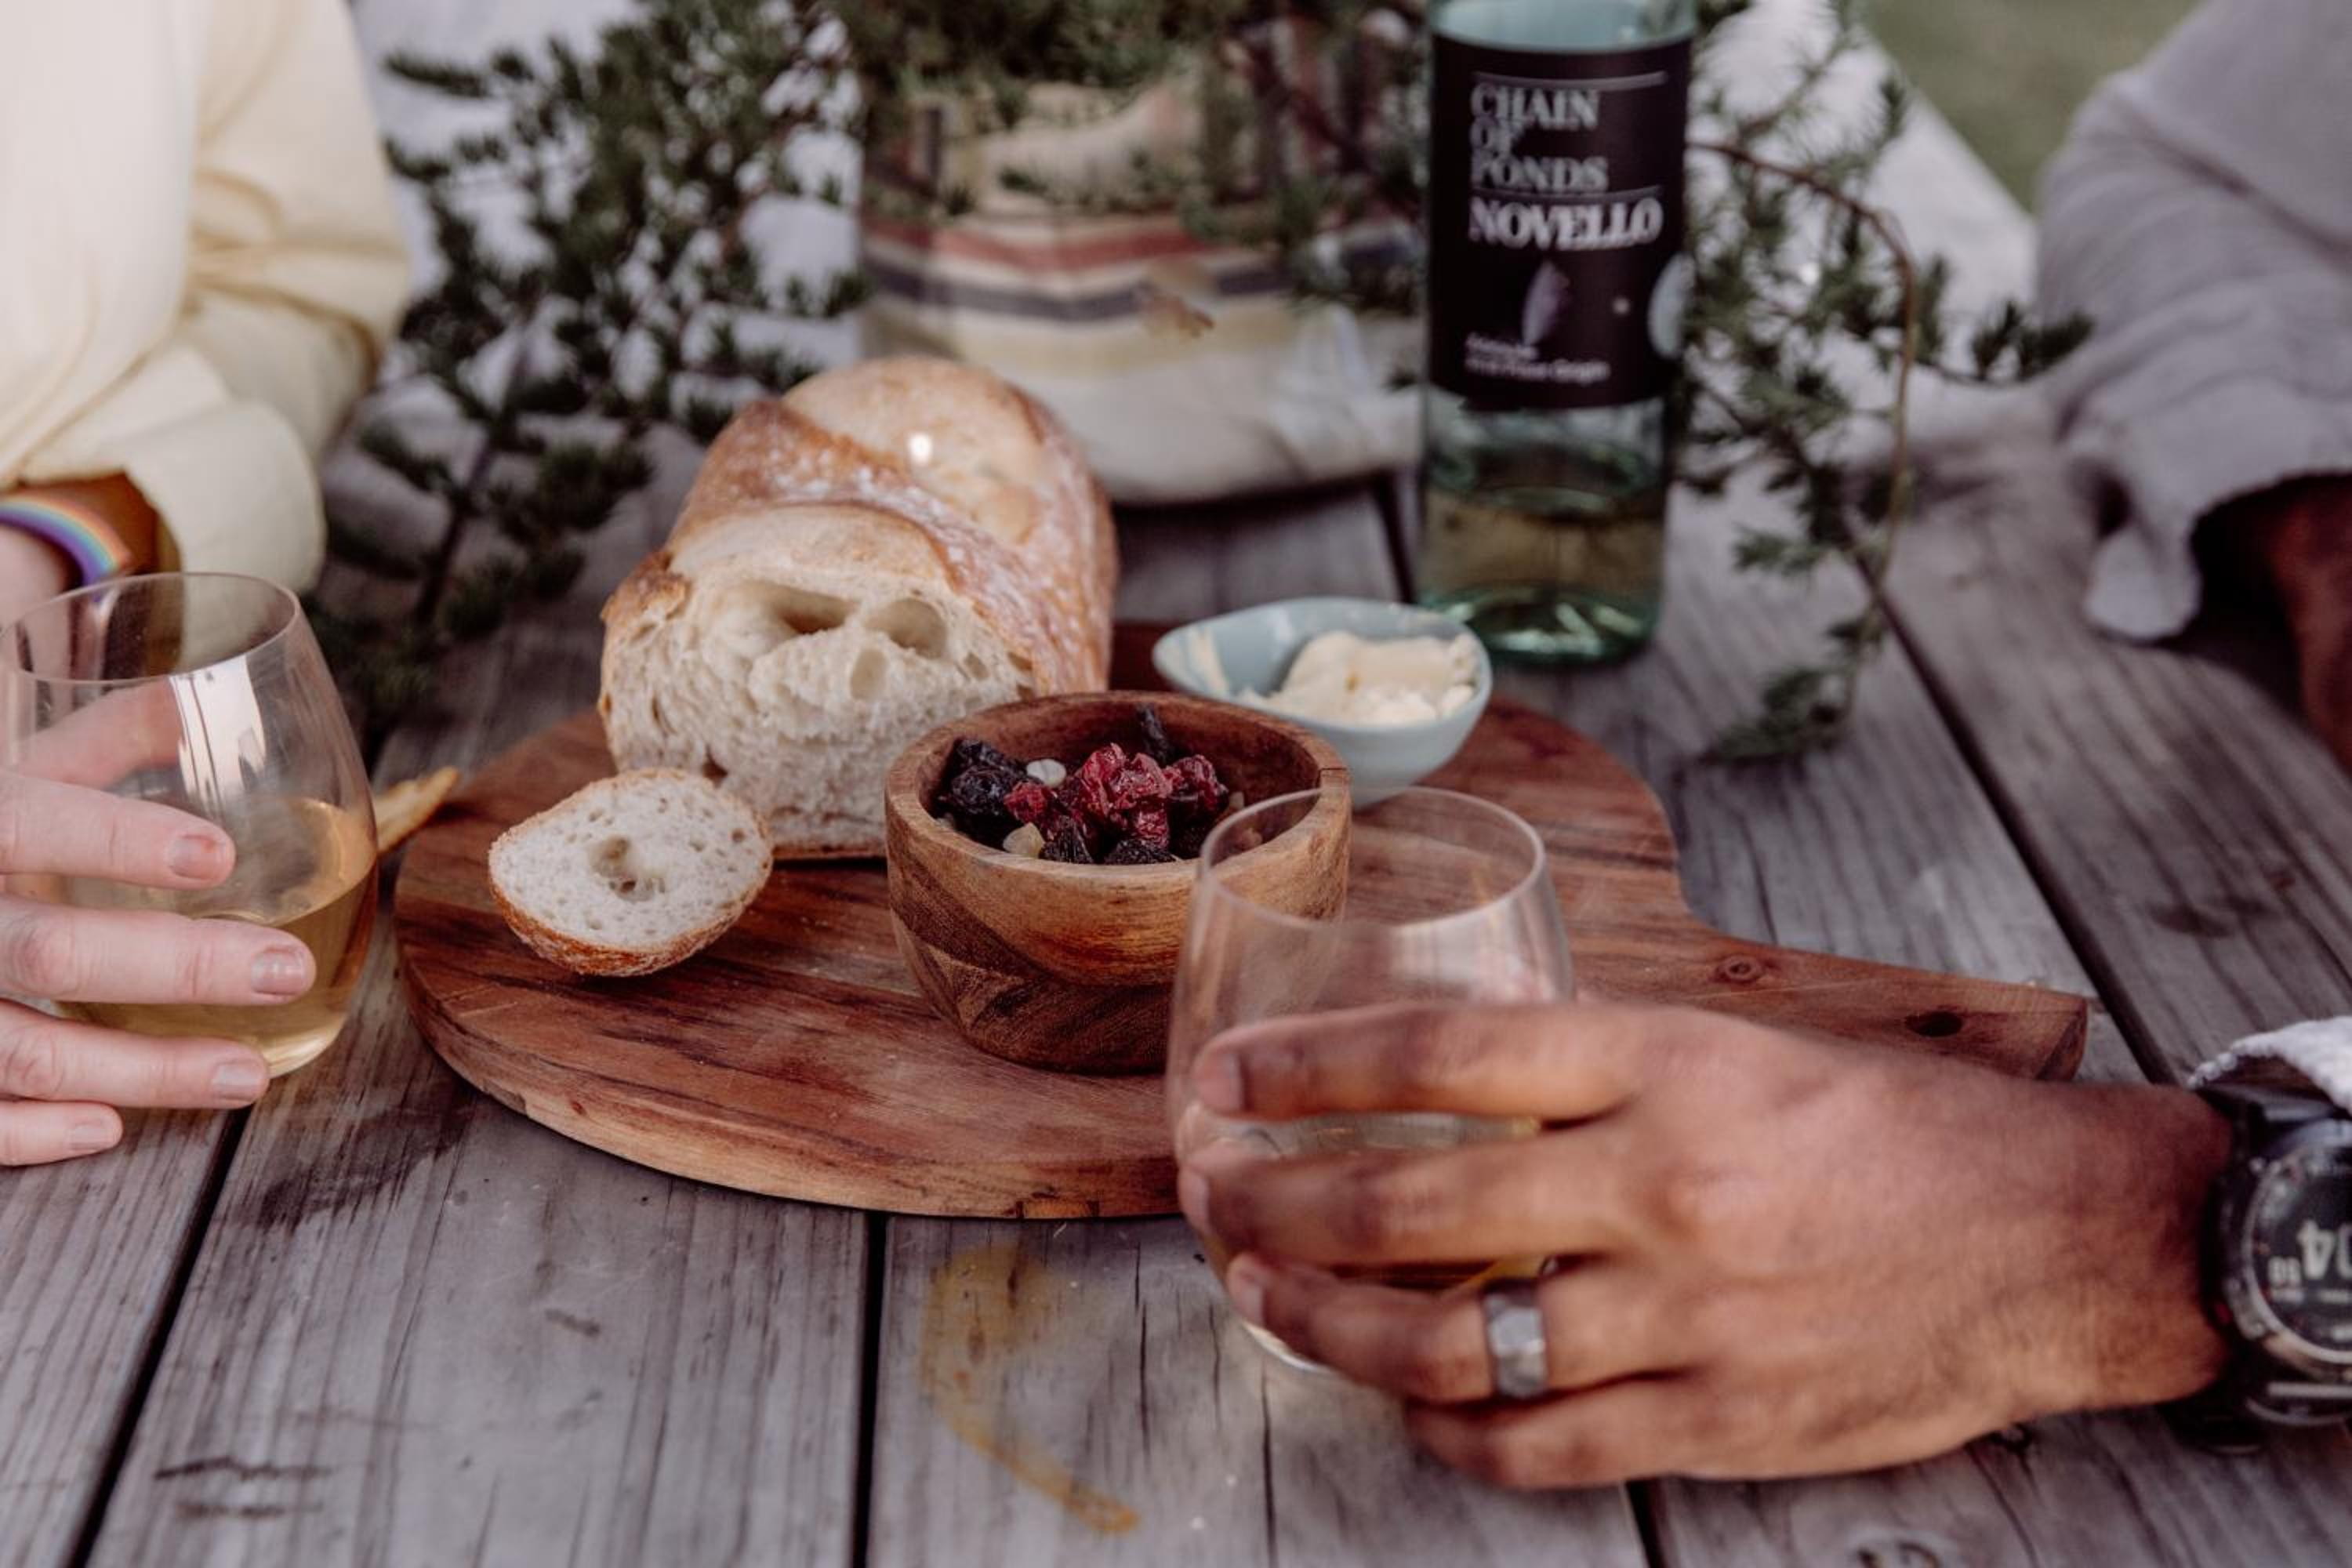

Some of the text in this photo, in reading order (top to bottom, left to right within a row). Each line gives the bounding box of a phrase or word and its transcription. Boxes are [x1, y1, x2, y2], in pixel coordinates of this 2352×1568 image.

[1471, 83, 1599, 131] CHAIN
[1471, 149, 1608, 194] PONDS
[1470, 196, 1664, 251] NOVELLO
